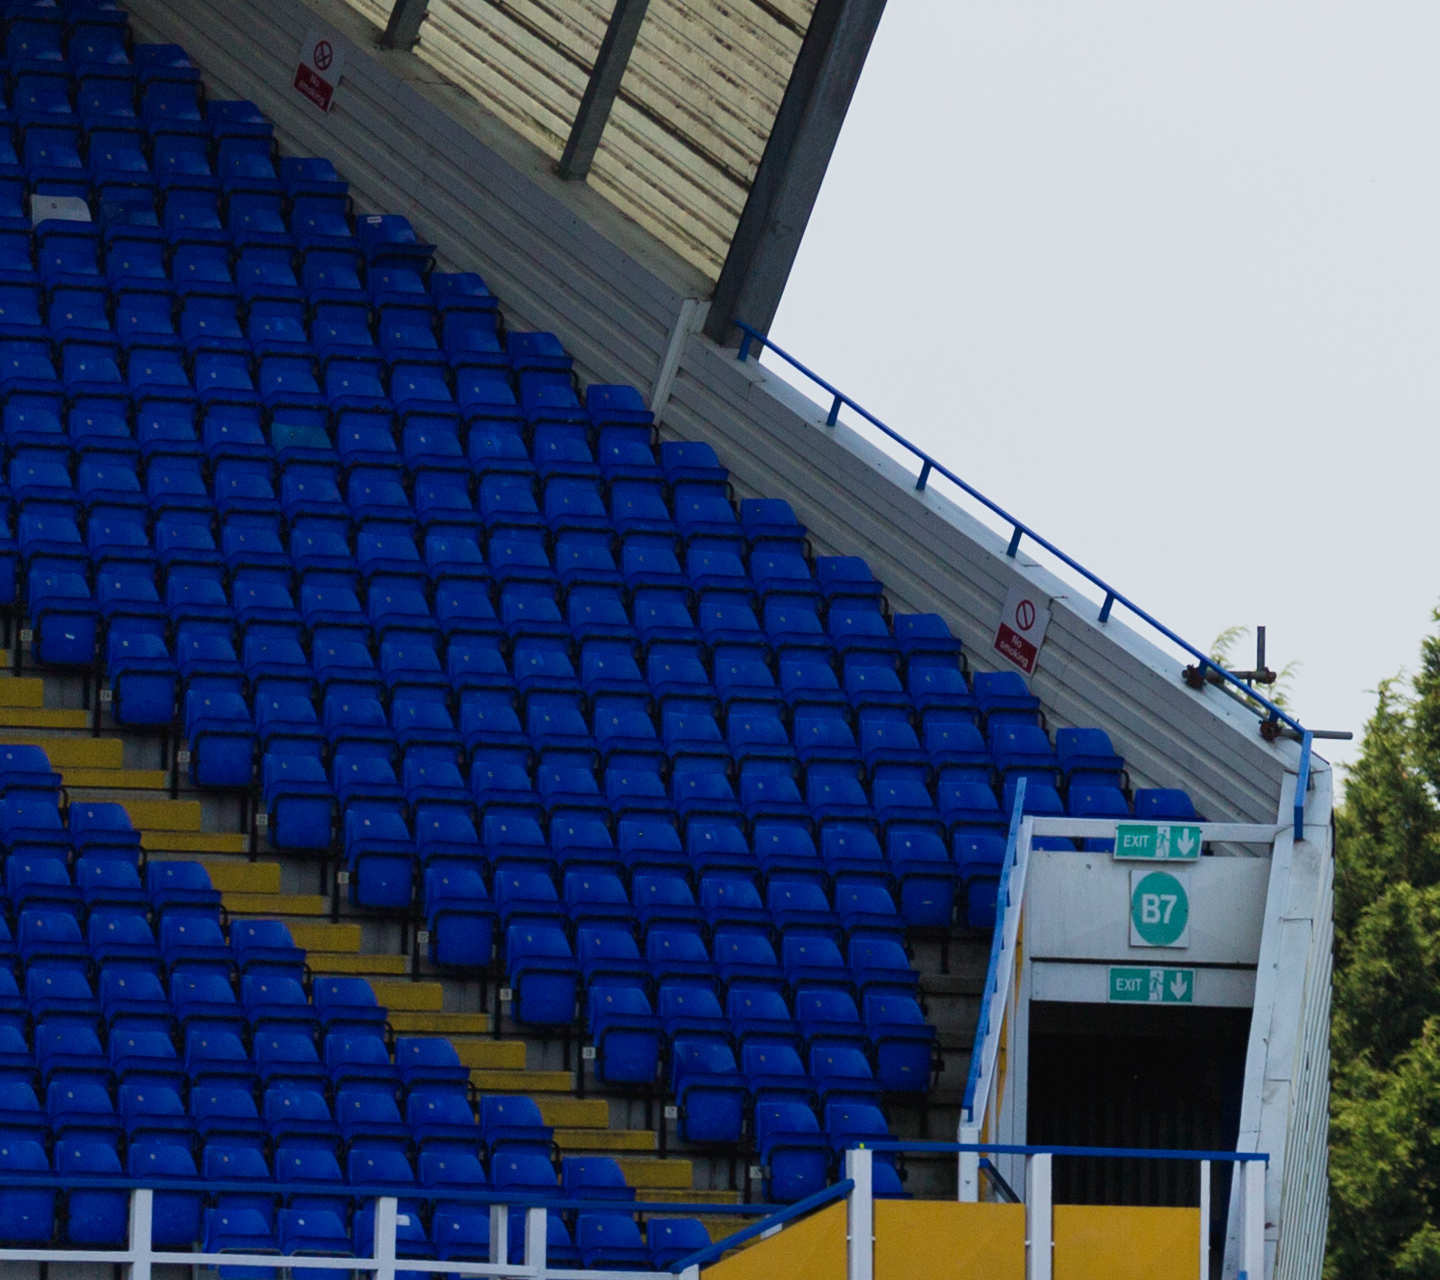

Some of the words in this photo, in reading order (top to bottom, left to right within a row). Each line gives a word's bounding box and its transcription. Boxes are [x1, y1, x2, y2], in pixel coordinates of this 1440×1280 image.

[1122, 834, 1150, 848] EXIT
[1141, 894, 1178, 924] B7
[1115, 978, 1143, 992] EXIT
